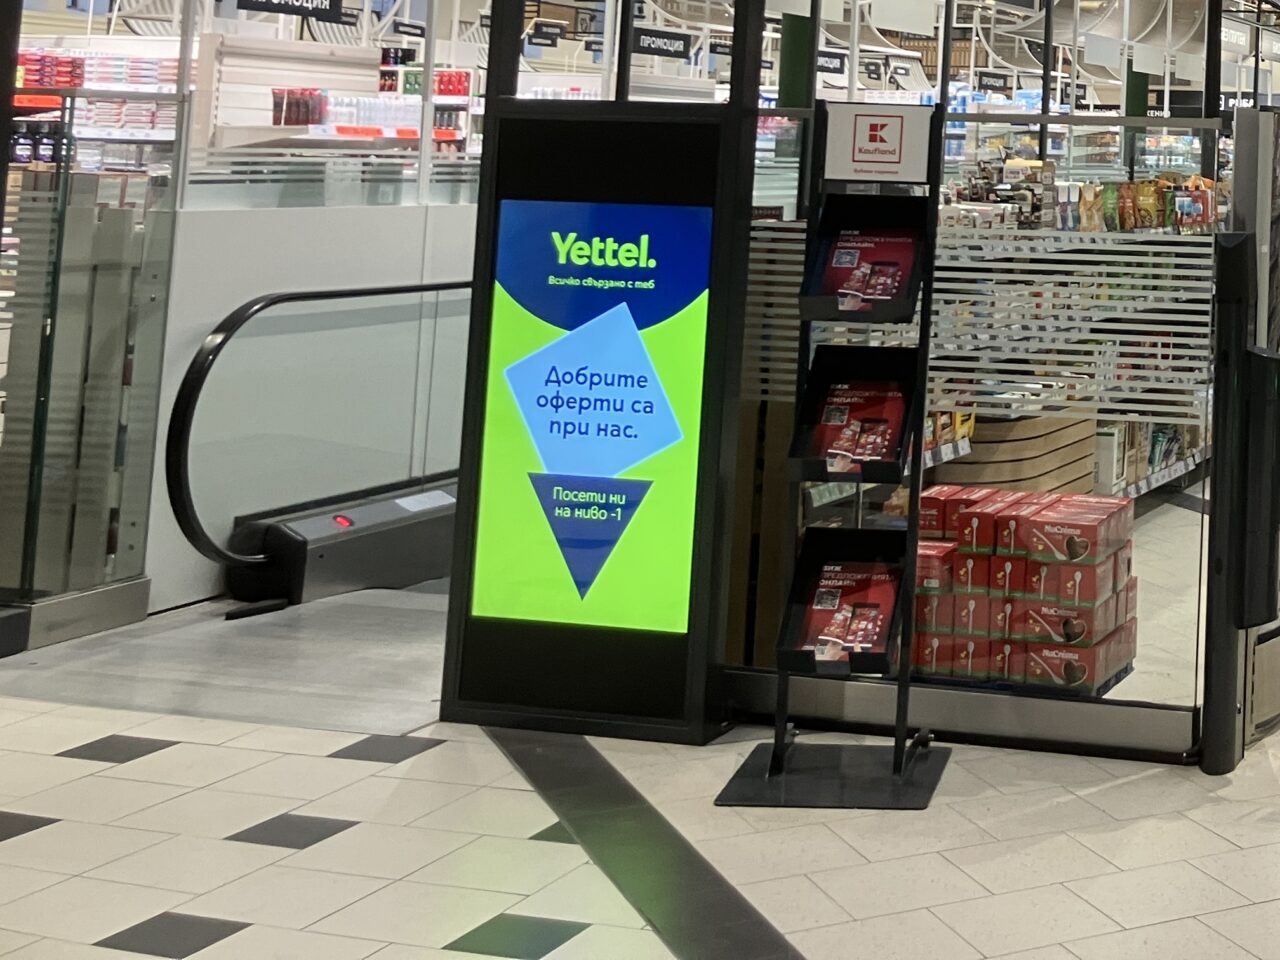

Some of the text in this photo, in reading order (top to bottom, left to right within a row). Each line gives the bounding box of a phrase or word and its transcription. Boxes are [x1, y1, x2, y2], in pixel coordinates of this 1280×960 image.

[640, 34, 686, 53] ПРОМОЦИЯ
[551, 231, 657, 268] Yettel.
[548, 275, 656, 289] Всичко свързано с теб
[545, 365, 649, 391] Добрите
[536, 390, 655, 415] оферти са
[549, 420, 639, 439] при нас.
[552, 486, 627, 505] Посети ни
[554, 505, 622, 521] на ниво -1
